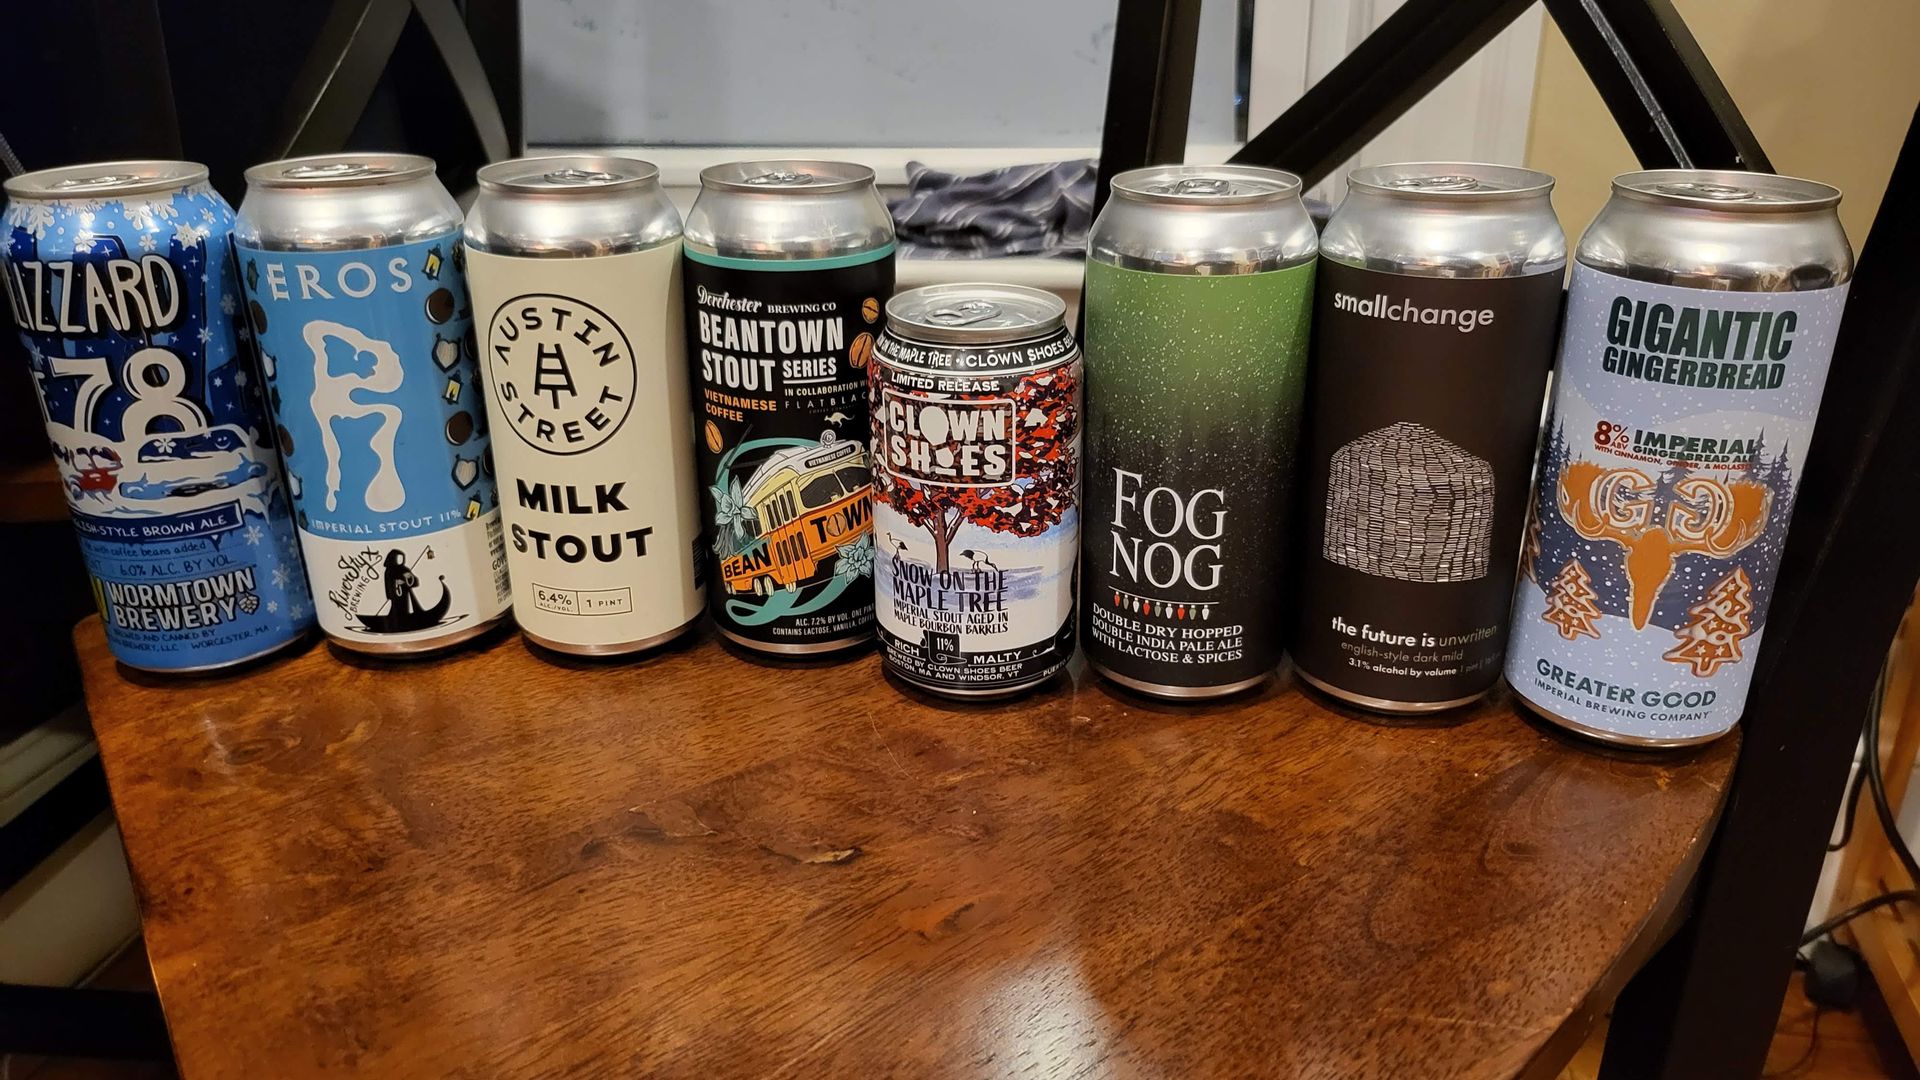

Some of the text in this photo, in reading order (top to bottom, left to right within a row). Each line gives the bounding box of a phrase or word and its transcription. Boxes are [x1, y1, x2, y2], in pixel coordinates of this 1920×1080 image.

[5, 254, 180, 333] LIZZARD
[266, 258, 413, 300] EROS
[697, 284, 837, 314] Dorchester BREWING CO
[1334, 292, 1495, 333] smallchange
[494, 307, 621, 367] AUSTIN
[699, 309, 844, 355] BEANTOWN
[1606, 296, 1798, 361] GIGANTIC
[701, 349, 837, 393] STOUT SERIES
[899, 347, 926, 363] MAPLE
[927, 350, 952, 368] TREE
[966, 351, 1023, 367] CLOWN
[1027, 340, 1065, 362] SHOES
[1602, 346, 1786, 390] GINGERBREAD
[48, 348, 208, 443] 78
[784, 388, 794, 397] IN
[796, 381, 858, 397] COLLABORATION
[891, 371, 1000, 392] LIMITED RELEASE
[500, 381, 623, 443] STREET
[704, 388, 777, 412] VIETNAMESE
[705, 402, 744, 423] COFFEE
[785, 391, 867, 409] FLATBLAC
[889, 400, 1005, 446] CLOWN
[1594, 420, 1756, 456] 8% IMPERIAL
[890, 435, 1006, 477] SHOES
[1594, 444, 1612, 454] WITH
[1614, 450, 1663, 465] CINNAMON,
[1611, 441, 1628, 450] ABV
[1632, 445, 1731, 463] GINGERBREAD
[516, 478, 630, 514] MILK
[1110, 467, 1228, 540] FOG
[142, 521, 195, 537] BROWN
[200, 515, 227, 532] ALE
[312, 509, 462, 534] IMPERIAL STOUT 11%
[141, 547, 171, 556] beans
[174, 541, 206, 553] added
[511, 523, 653, 563] STOUT
[183, 560, 202, 573] BY
[723, 543, 772, 579] BEAN
[892, 557, 1009, 591] SNOW ON THE
[1109, 530, 1224, 591] NOG
[107, 567, 254, 607] WORMTOWN
[349, 576, 371, 613] BREWING
[538, 590, 622, 608] 6.4% 1 PINT
[893, 576, 1009, 613] MAPLE TREE
[115, 597, 236, 631] BREWERY
[795, 617, 810, 627] ALC.
[811, 617, 827, 625] 7.2%
[828, 614, 836, 624] BY
[851, 606, 862, 618] ONE
[894, 598, 1008, 624] IMPERIAL STOUT AGED IN
[894, 609, 1008, 635] MAPLE BOURBON BARRELS
[1093, 602, 1243, 639] DOUBLE DRY HOPPED
[203, 629, 216, 637] BY
[255, 624, 269, 634] MA
[772, 627, 803, 636] CONTAINS
[803, 625, 832, 636] LACTOSE,
[1092, 615, 1243, 651] DOUBLE INDIA PALE ALE
[1092, 627, 1243, 664] WITH LACTOSE & SPICES
[1331, 616, 1497, 647] the future is unwritten
[887, 646, 912, 664] BREWED
[914, 660, 925, 668] BY
[928, 664, 961, 675] CLOWN
[999, 663, 1023, 672] BEER
[894, 637, 1022, 664] RICH 11% MALTY
[1341, 641, 1463, 664] english-style dark mild
[1348, 657, 1371, 670] 3.1%
[1372, 664, 1408, 676] alcohol
[1410, 667, 1422, 678] by
[1424, 667, 1457, 676] volume
[918, 667, 932, 677] MA
[935, 671, 956, 680] AND
[958, 673, 1005, 681] WINDSOR,
[1007, 670, 1020, 678] VT
[1537, 659, 1717, 708] GREATER GOOD
[1535, 677, 1708, 721] IMPERIAL BREWING COMPANY
